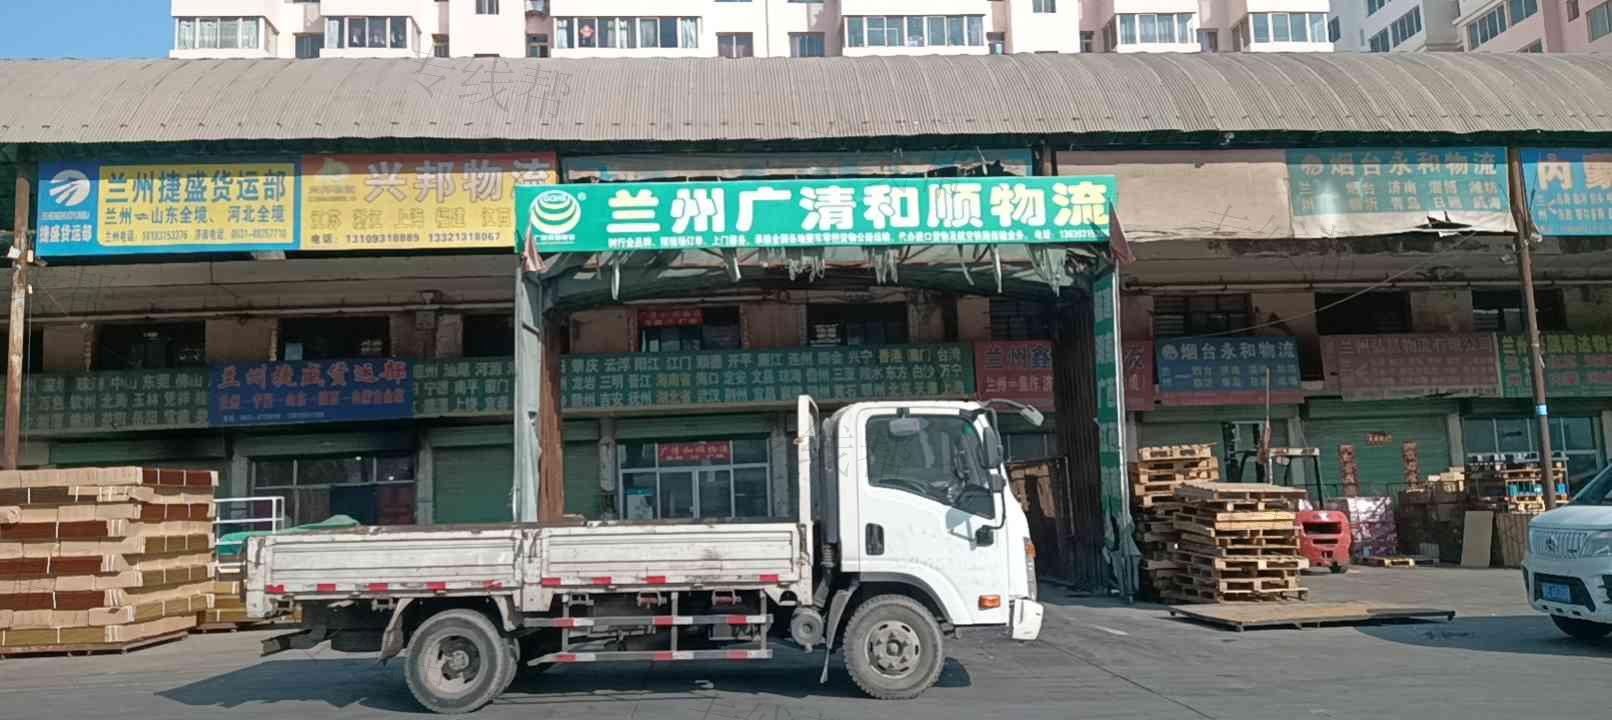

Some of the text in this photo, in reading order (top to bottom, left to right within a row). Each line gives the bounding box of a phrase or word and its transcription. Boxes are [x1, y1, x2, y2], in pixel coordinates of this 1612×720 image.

[1329, 152, 1497, 176] 烟台永和物流
[105, 169, 287, 203] 兰州捷盛货运部
[104, 208, 133, 226] 兰州
[606, 181, 1110, 233] 兰州广清和顺物流
[665, 356, 692, 370] 江门
[727, 353, 753, 368] 开平
[937, 346, 961, 362] 台湾
[1180, 341, 1296, 361] 烟台永和物流
[111, 374, 137, 390] 中山
[599, 373, 624, 390] 三明
[912, 365, 936, 377] 白沙
[940, 363, 963, 377] 万宁
